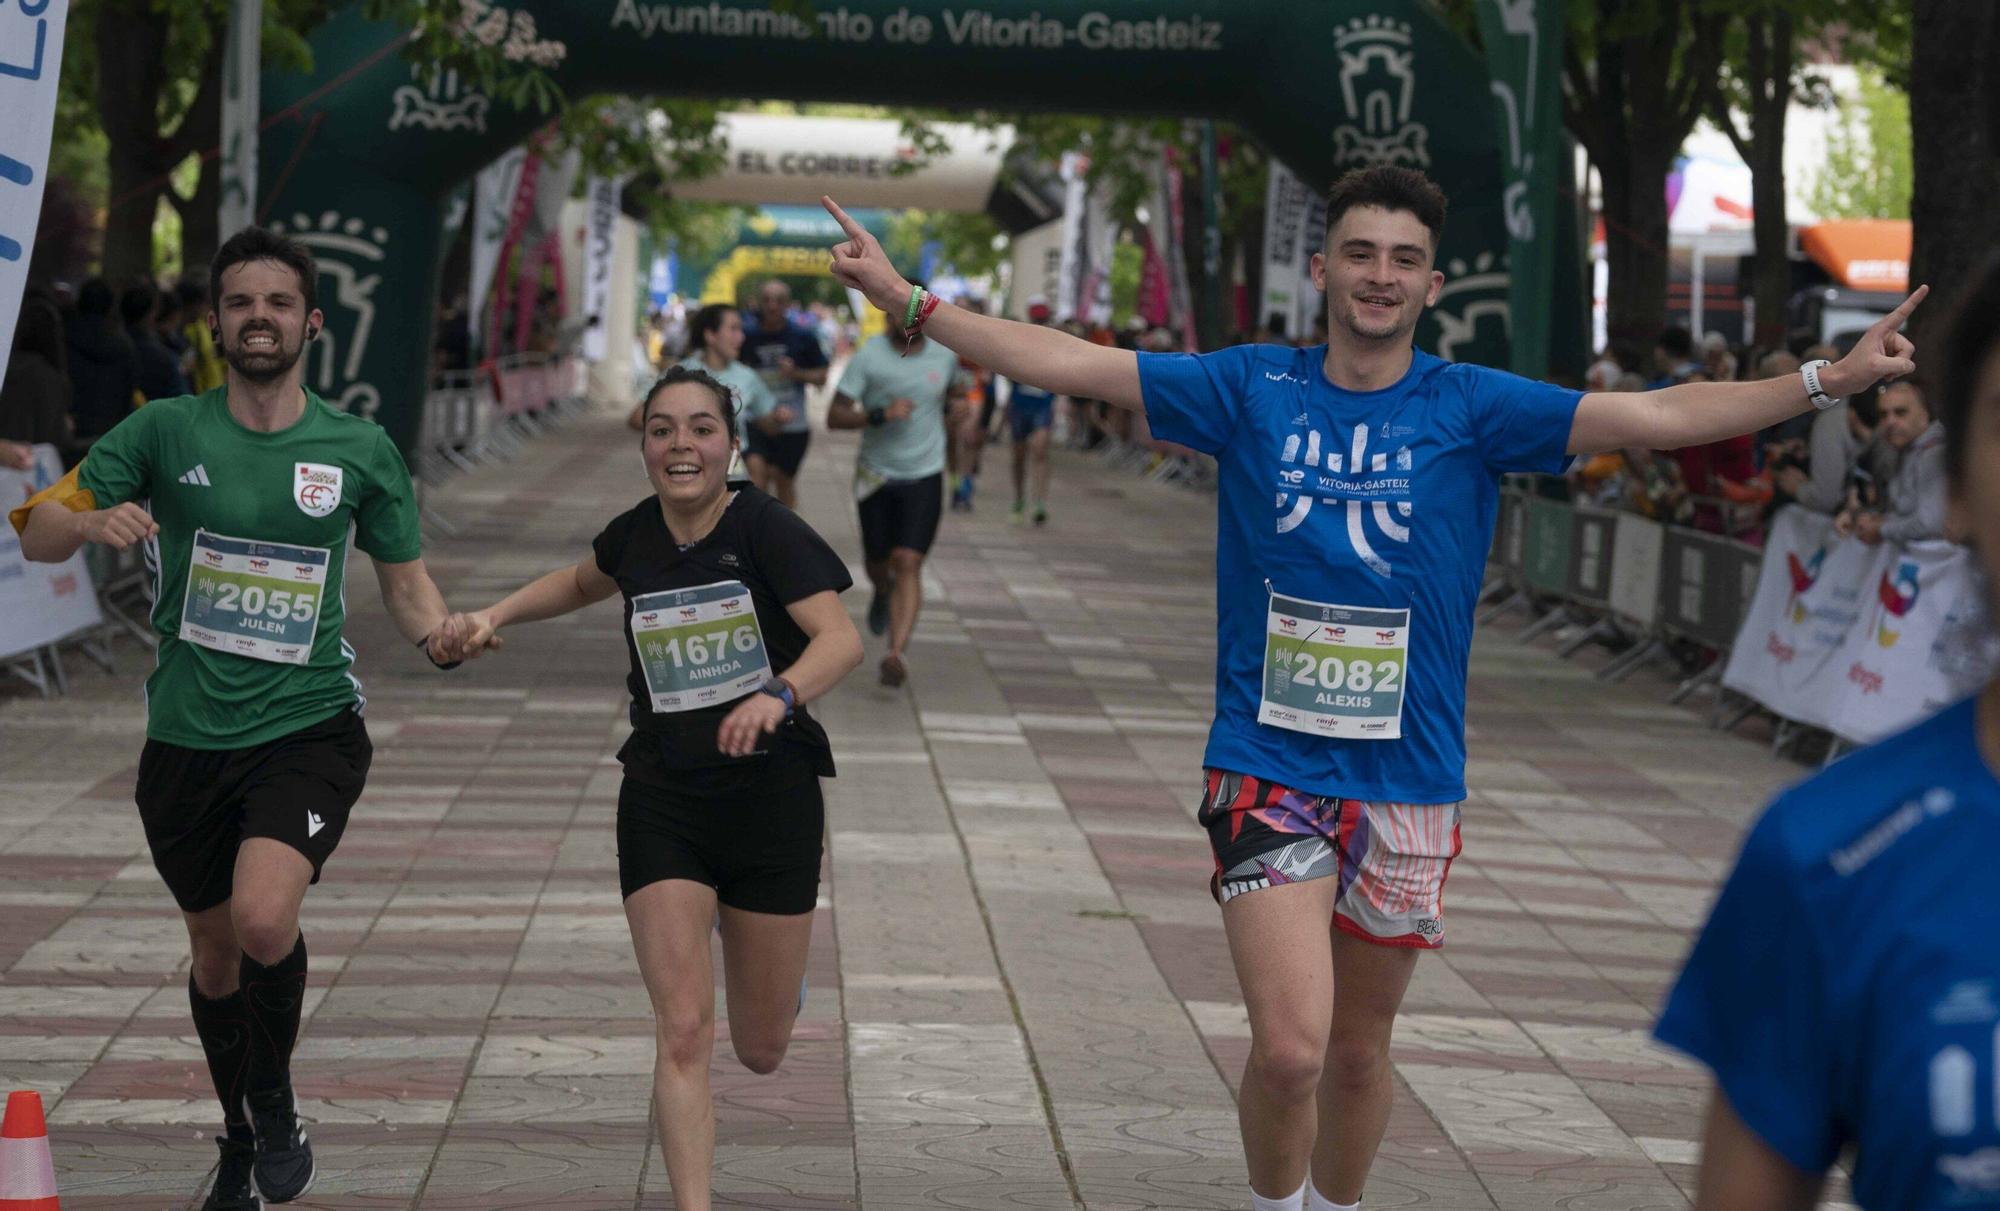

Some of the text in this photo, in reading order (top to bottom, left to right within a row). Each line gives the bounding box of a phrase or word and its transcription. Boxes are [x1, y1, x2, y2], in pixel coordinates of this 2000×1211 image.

[882, 6, 933, 44] de
[943, 8, 1223, 50] Vitoria-Gasteiz
[738, 151, 896, 178] EL CORRE
[1319, 476, 1410, 491] VITORIA-GASTEIZ
[213, 582, 315, 623] 2055
[239, 617, 286, 635] JULEN
[665, 624, 758, 668] 1676
[689, 659, 742, 681] AINHOA
[1292, 652, 1400, 693] 2082
[1315, 692, 1372, 708] ALEXIS
[1316, 717, 1339, 728] renfe
